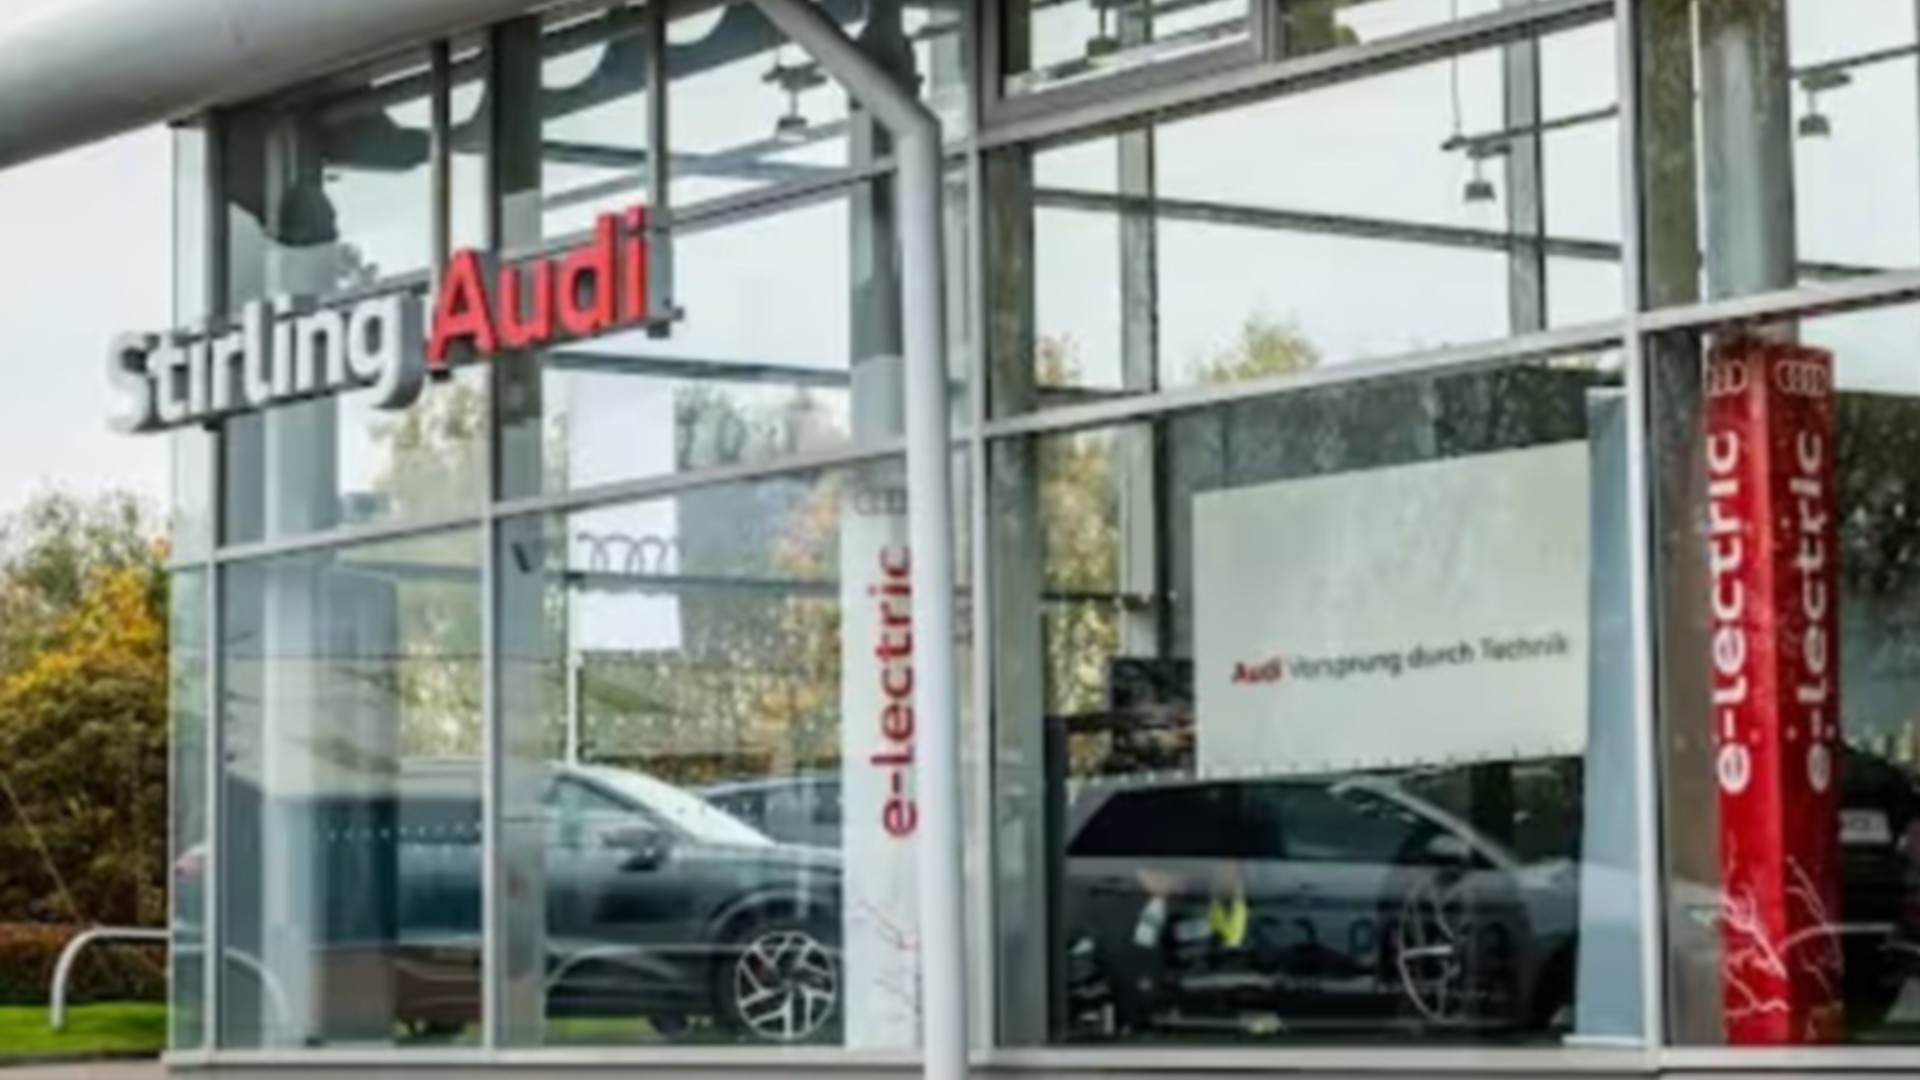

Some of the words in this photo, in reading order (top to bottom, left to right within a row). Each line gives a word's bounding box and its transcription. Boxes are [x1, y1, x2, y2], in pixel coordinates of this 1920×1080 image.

[104, 294, 412, 433] Stirling
[425, 204, 649, 372] Audi
[868, 546, 918, 838] e-lectric
[1230, 656, 1283, 684] Audi
[1288, 653, 1403, 681] Vorsprung
[1406, 642, 1476, 670] durch
[1480, 630, 1568, 661] Technik
[1707, 430, 1751, 794] e-lectric
[1791, 430, 1830, 794] e-lectric
